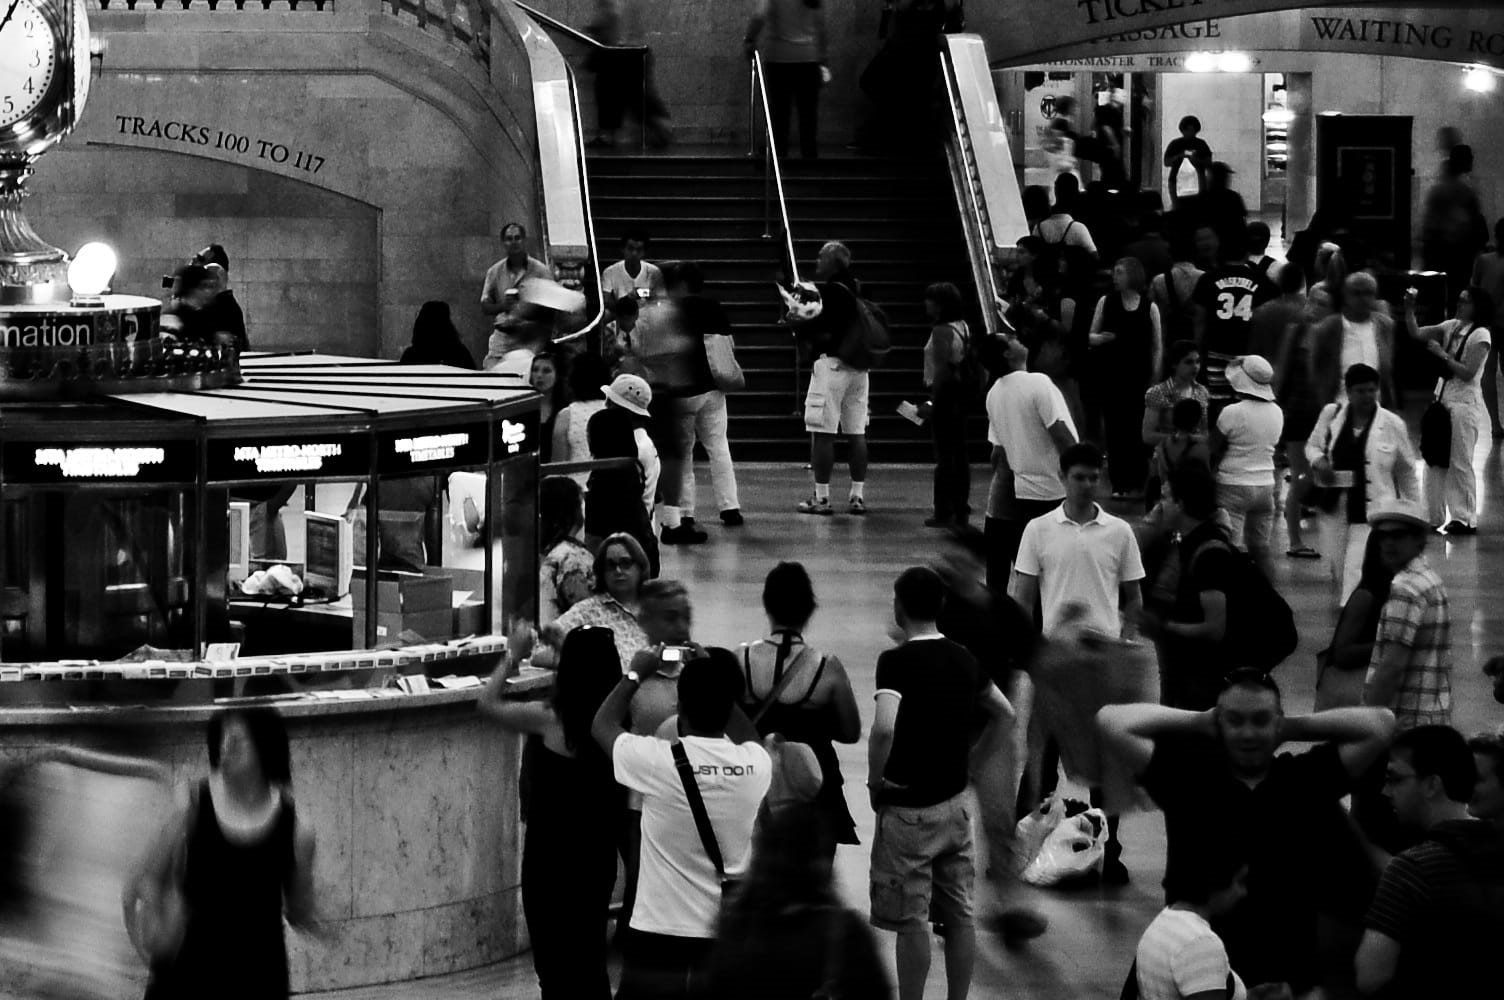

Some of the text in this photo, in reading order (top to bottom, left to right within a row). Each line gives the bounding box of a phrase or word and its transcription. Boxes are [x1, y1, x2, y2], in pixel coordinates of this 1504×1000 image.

[24, 20, 34, 38] 2
[1090, 18, 1222, 44] SSAGE
[1311, 17, 1453, 49] WAITING
[28, 49, 41, 68] 3
[1147, 56, 1186, 67] TRAC
[22, 76, 35, 94] 4
[2, 96, 14, 113] 5
[116, 115, 325, 174] TRACKS 100 TO 117
[1216, 292, 1253, 321] 34
[693, 765, 718, 775] UST
[722, 766, 744, 776] DO
